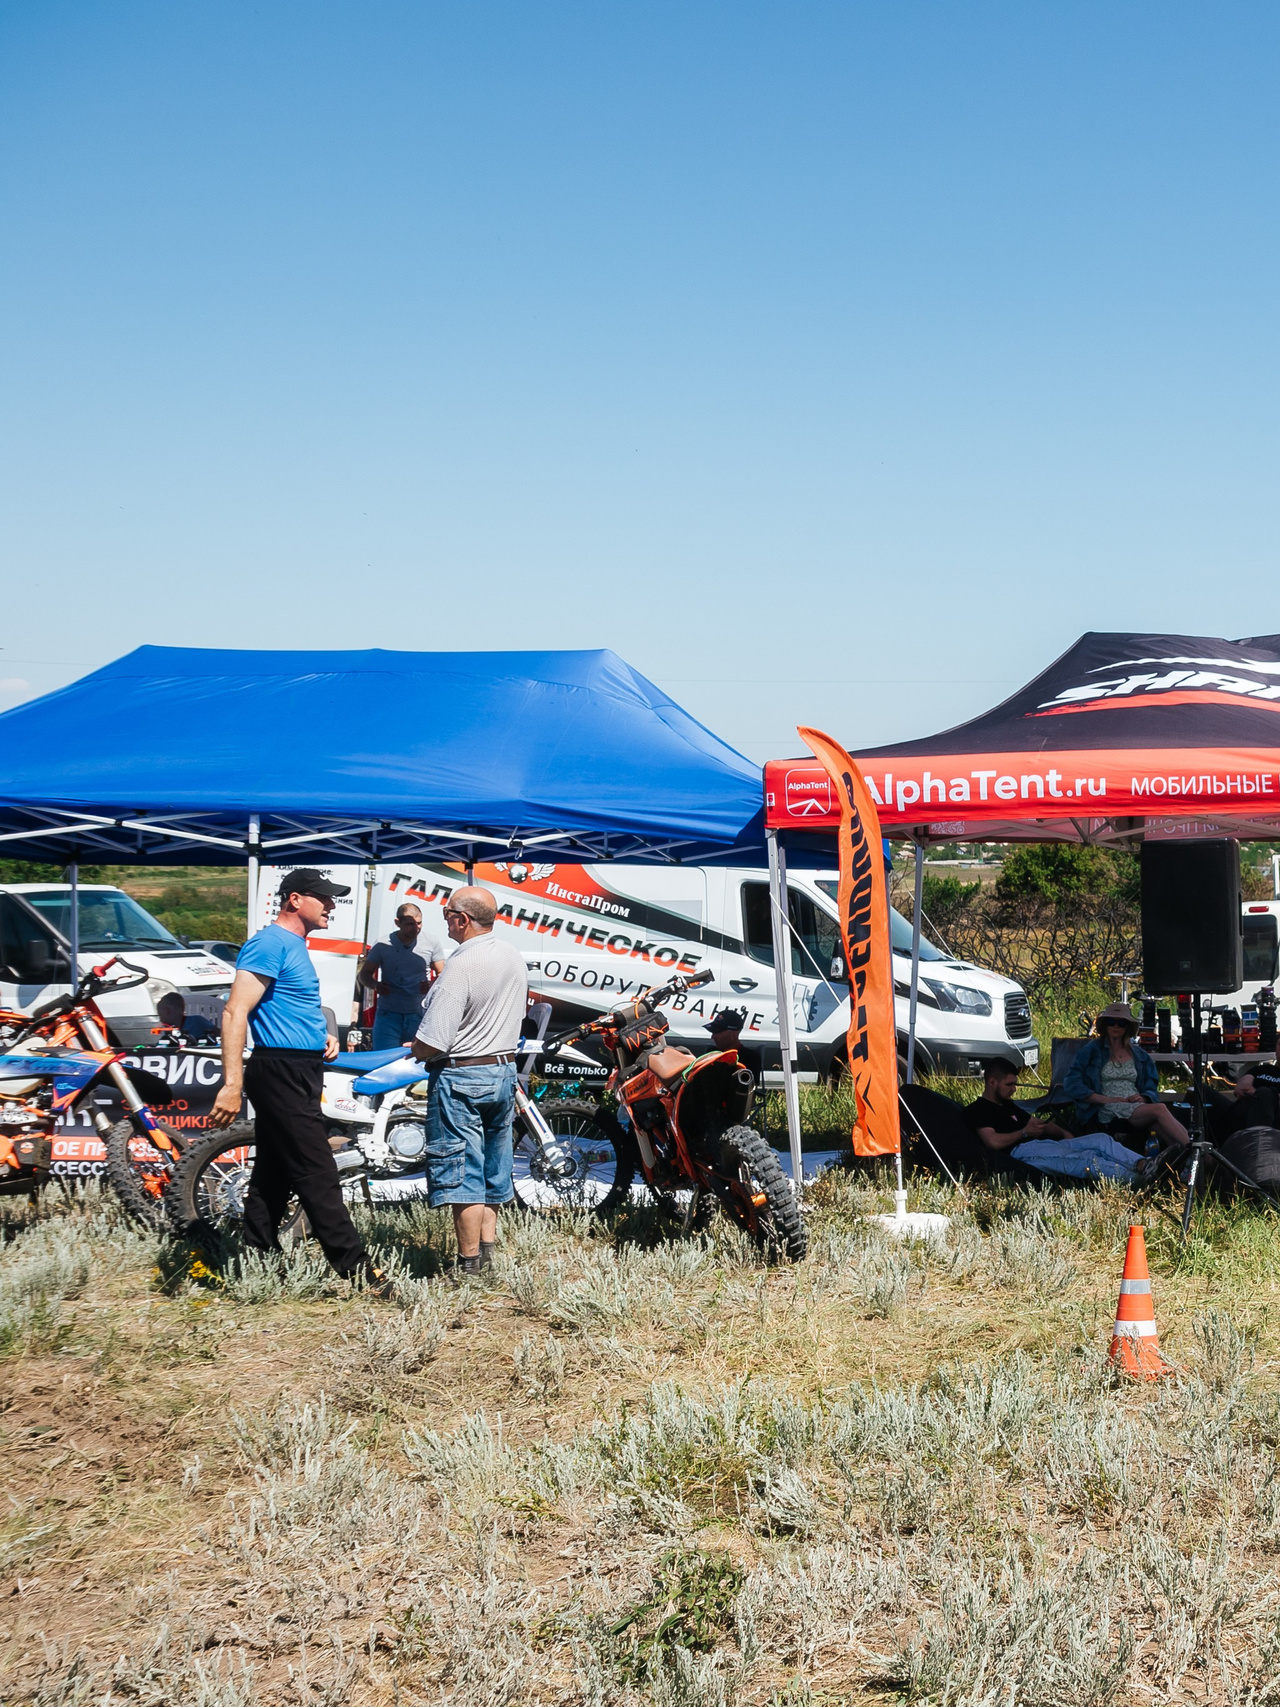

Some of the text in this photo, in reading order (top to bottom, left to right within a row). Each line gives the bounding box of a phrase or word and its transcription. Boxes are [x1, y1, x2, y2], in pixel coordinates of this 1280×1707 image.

[788, 781, 828, 791] AlphaTent
[1131, 773, 1275, 796] МОБИЛЬНЫЕ
[545, 881, 630, 918] ИнстаПром
[388, 872, 702, 974] ГАЛАНИЧЕСКОЕ
[544, 1063, 608, 1075] Всё только
